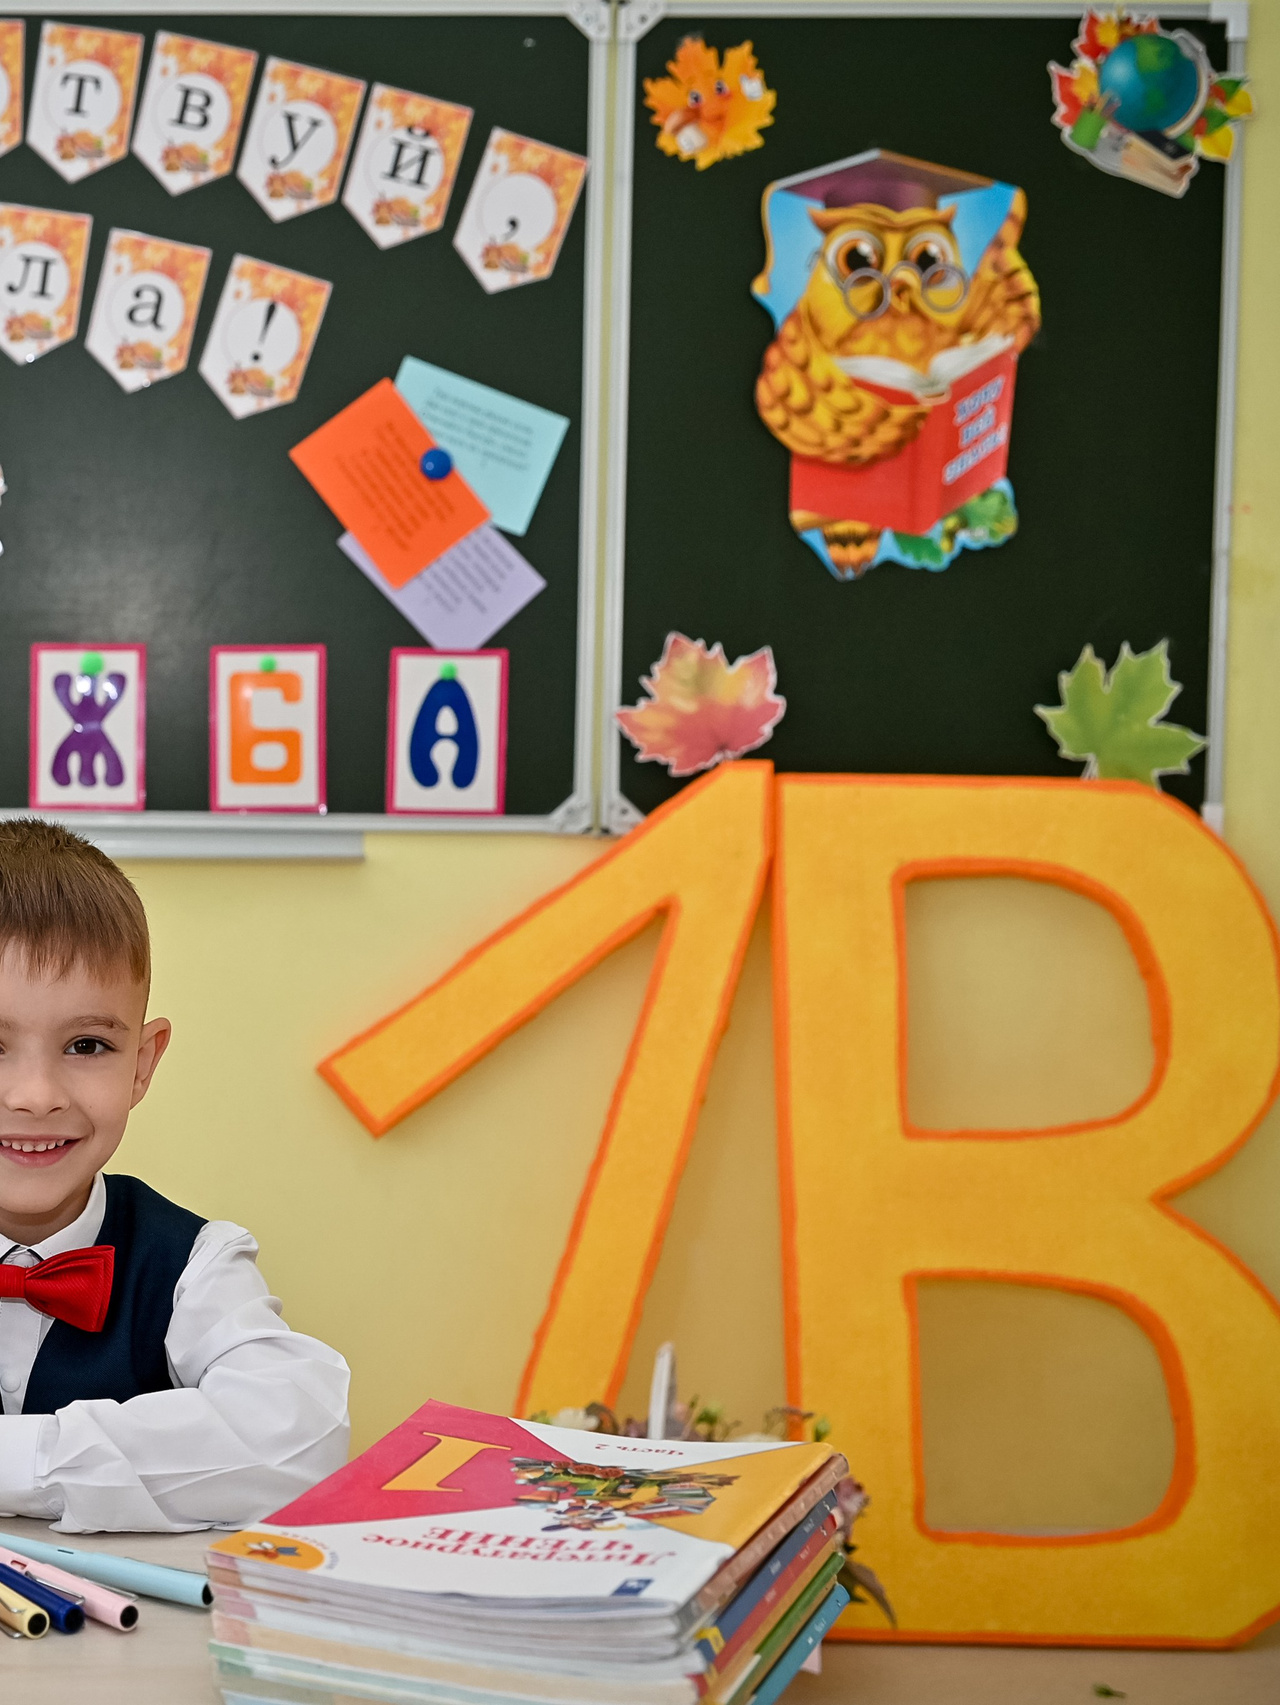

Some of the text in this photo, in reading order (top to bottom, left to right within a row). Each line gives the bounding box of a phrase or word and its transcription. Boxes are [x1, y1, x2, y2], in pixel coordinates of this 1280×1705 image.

[381, 1431, 512, 1492] 1
[616, 1445, 684, 1456] Часть
[361, 1533, 677, 1567] Литературное
[422, 1526, 634, 1552] ЧТЕНИЕ
